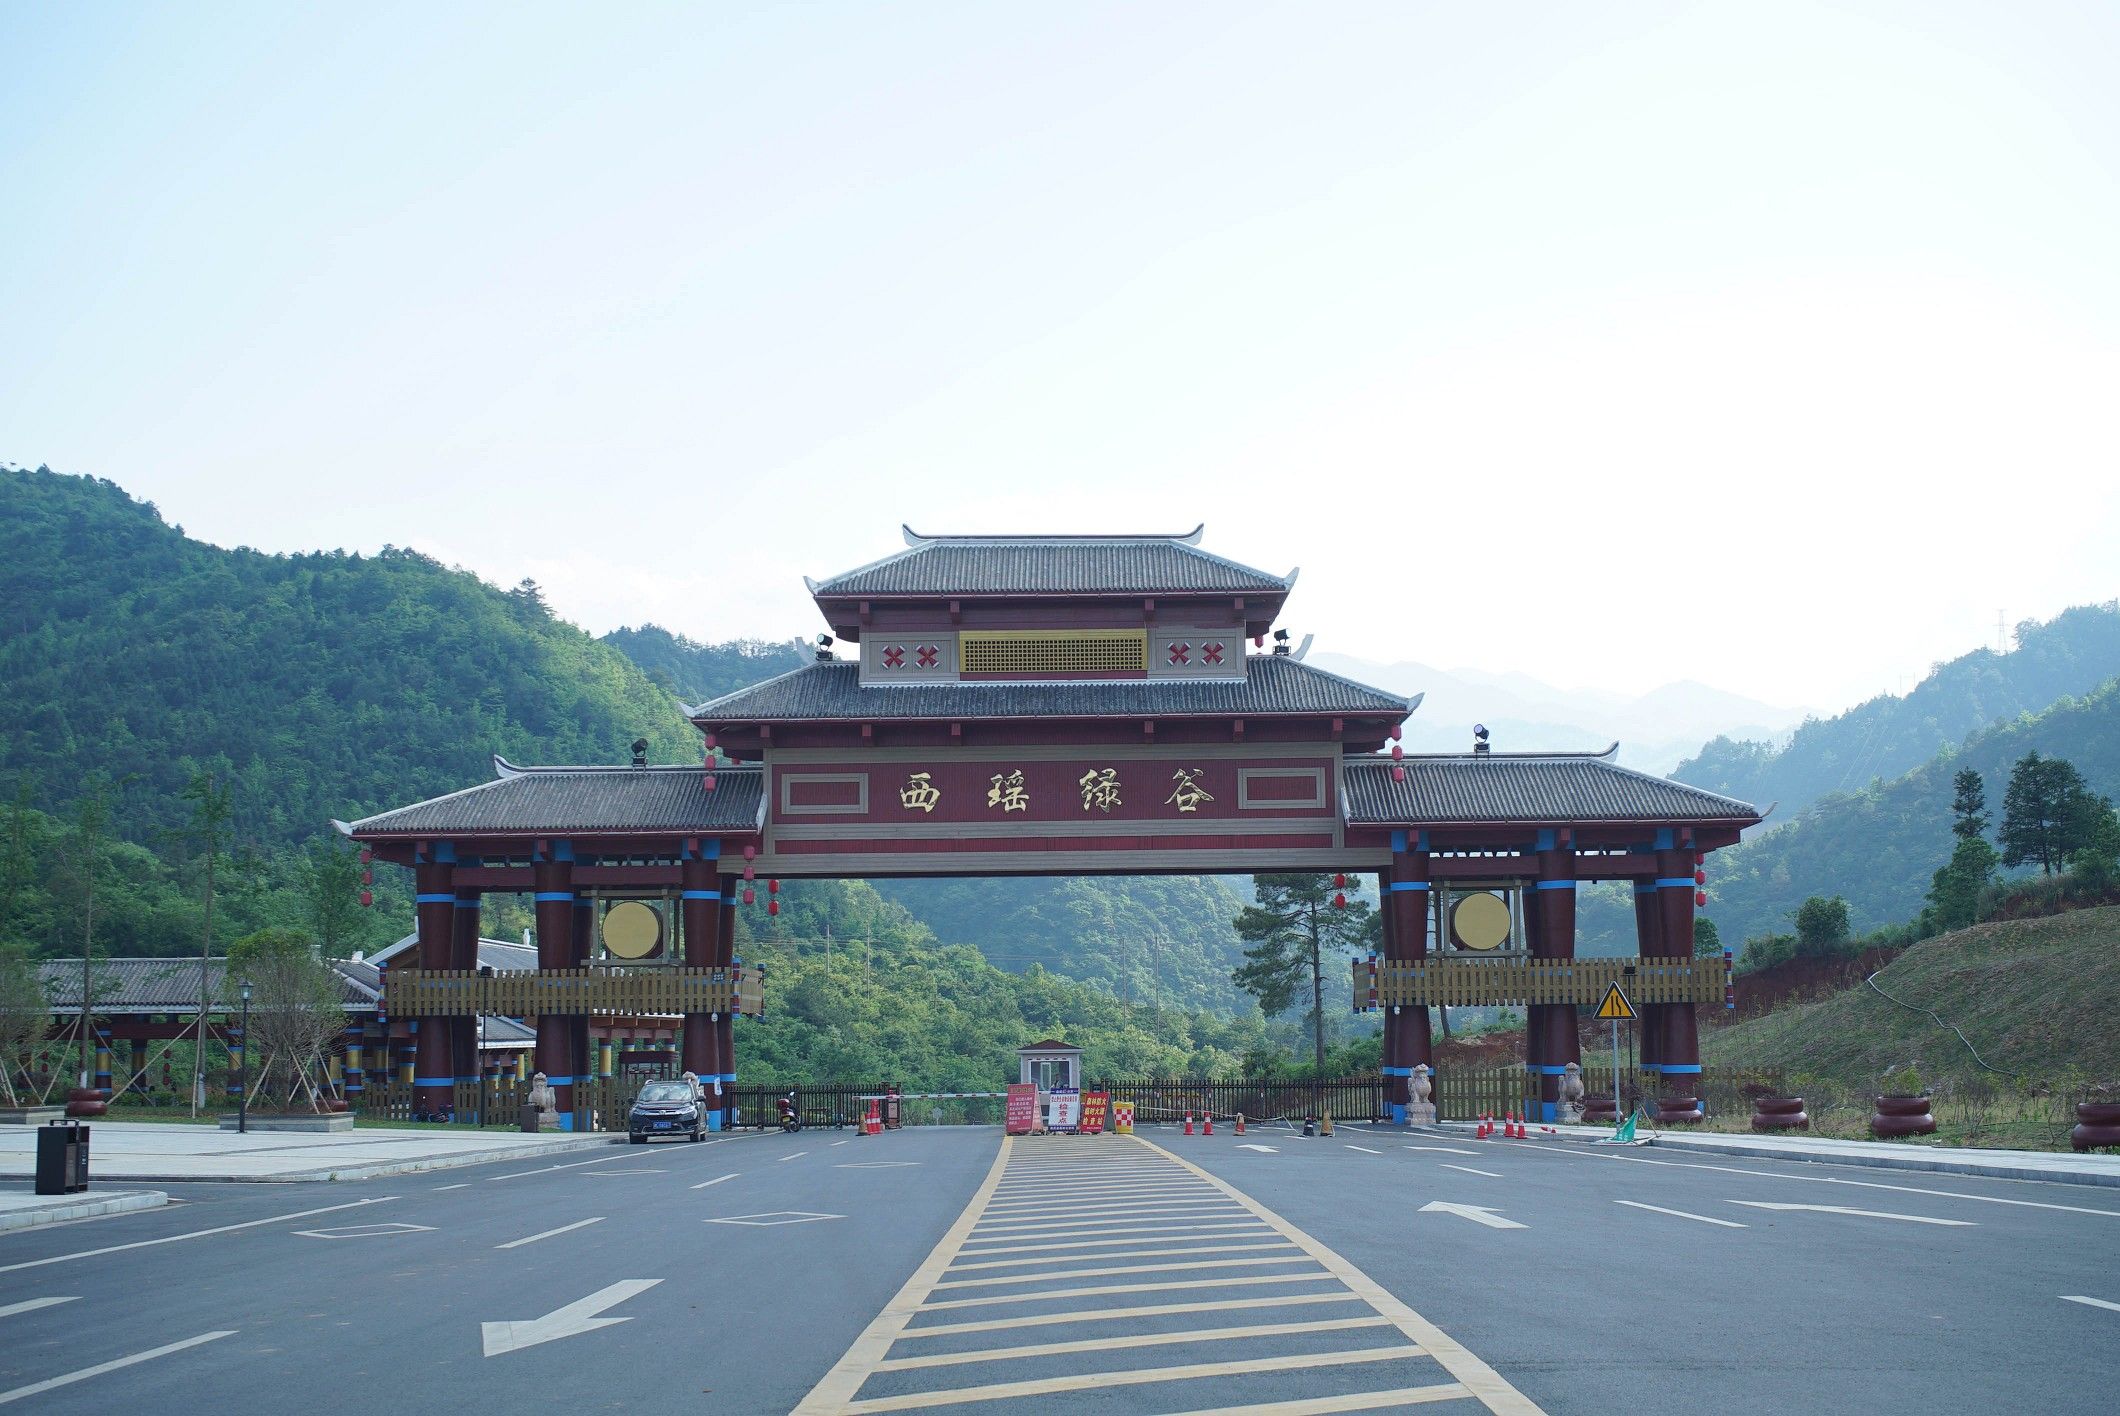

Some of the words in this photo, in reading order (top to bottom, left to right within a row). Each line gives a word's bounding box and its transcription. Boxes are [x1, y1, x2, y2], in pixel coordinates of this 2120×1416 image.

[900, 768, 1215, 814] 西瑶绿谷
[1086, 1097, 1107, 1106] 森林防火
[1058, 1103, 1068, 1124] 检查点
